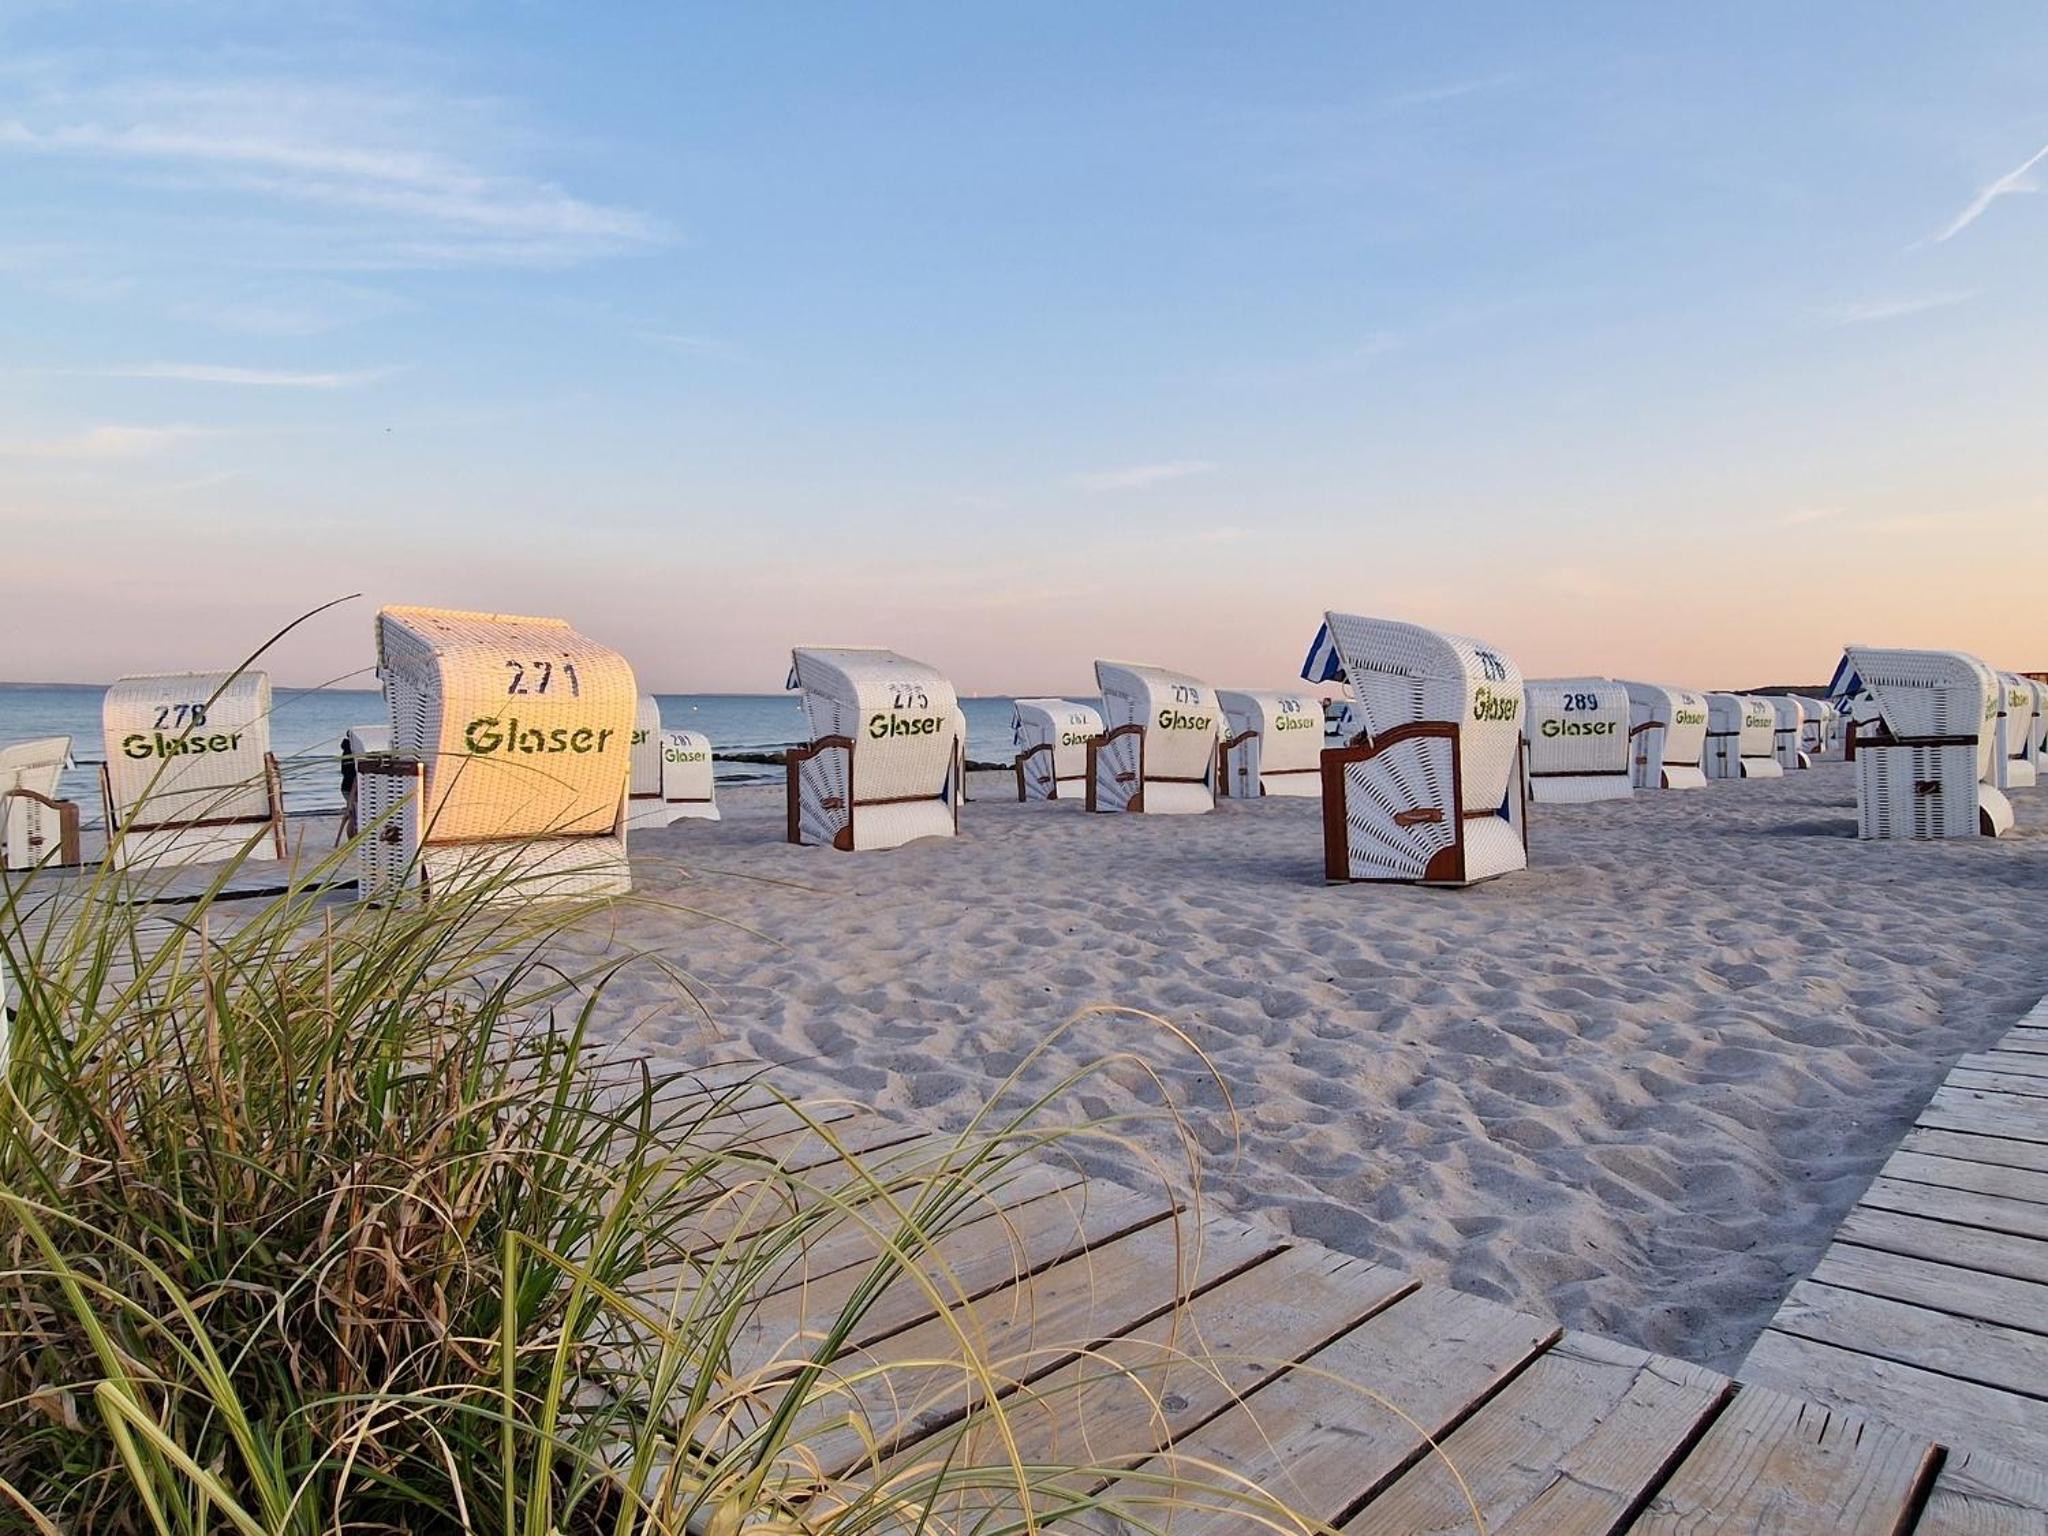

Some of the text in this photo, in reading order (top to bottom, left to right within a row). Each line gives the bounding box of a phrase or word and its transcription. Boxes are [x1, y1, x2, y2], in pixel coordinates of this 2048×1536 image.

[506, 660, 579, 697] 271
[1473, 686, 1519, 720] Glaser
[1563, 693, 1598, 712] 289
[154, 703, 207, 730] 278
[869, 713, 945, 739] Glaser
[1159, 709, 1212, 730] Glaser
[1275, 716, 1314, 731] Glaser
[1675, 710, 1705, 725] Glaser
[465, 716, 614, 753] Glaser
[1541, 719, 1617, 738] Glaser
[122, 732, 243, 759] Glaser
[665, 748, 706, 763] Glaser
